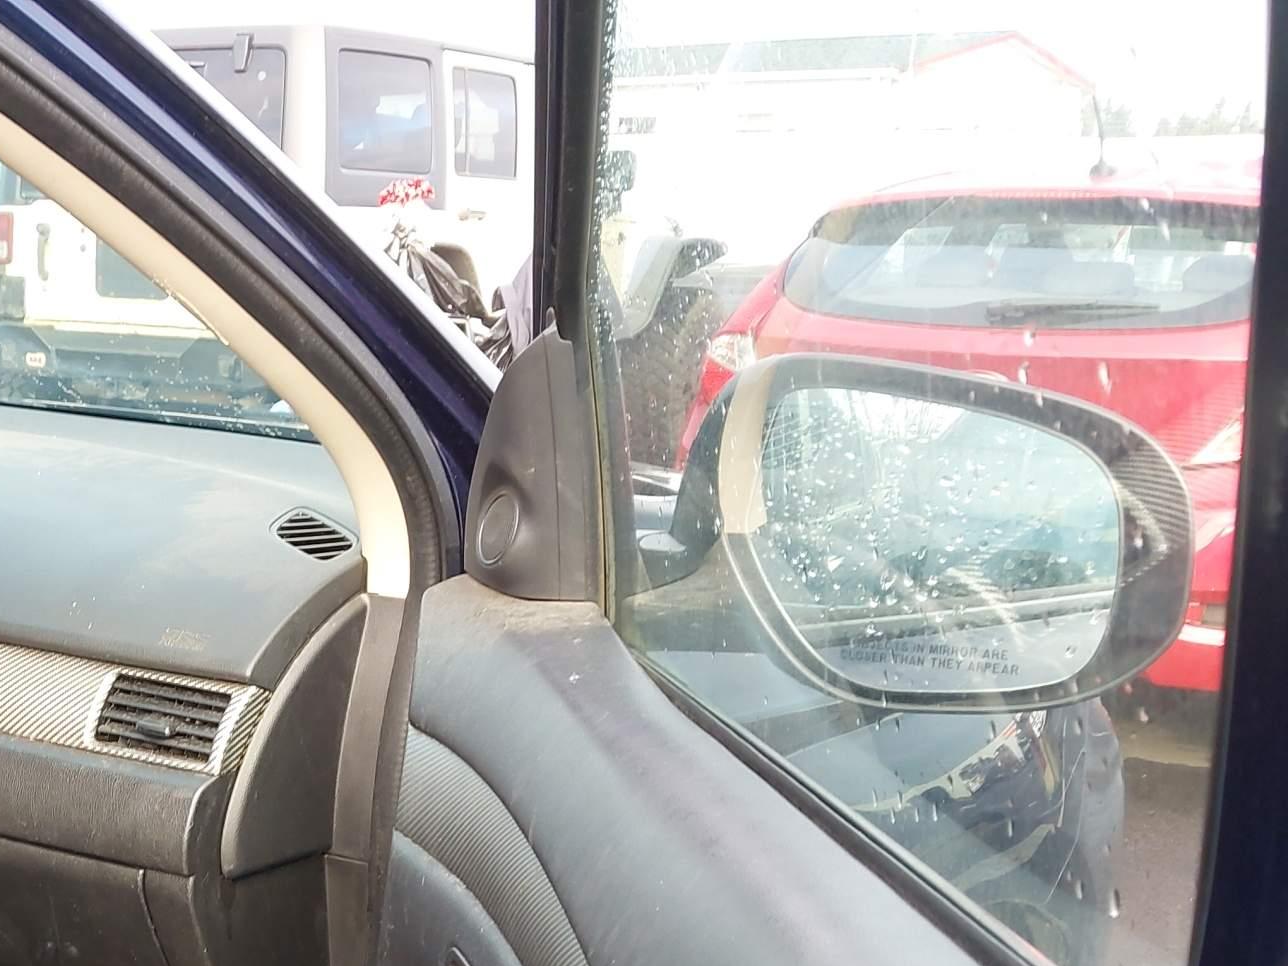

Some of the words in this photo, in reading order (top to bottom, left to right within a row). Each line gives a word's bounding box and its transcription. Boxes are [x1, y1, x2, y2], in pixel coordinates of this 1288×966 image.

[840, 648, 887, 662] CLOSER
[893, 655, 925, 667] THAN
[931, 656, 963, 670] THEY
[968, 661, 1020, 676] APPEAR
[913, 643, 925, 654] IN
[929, 644, 978, 659] MIRROR
[982, 649, 1009, 661] ARE
